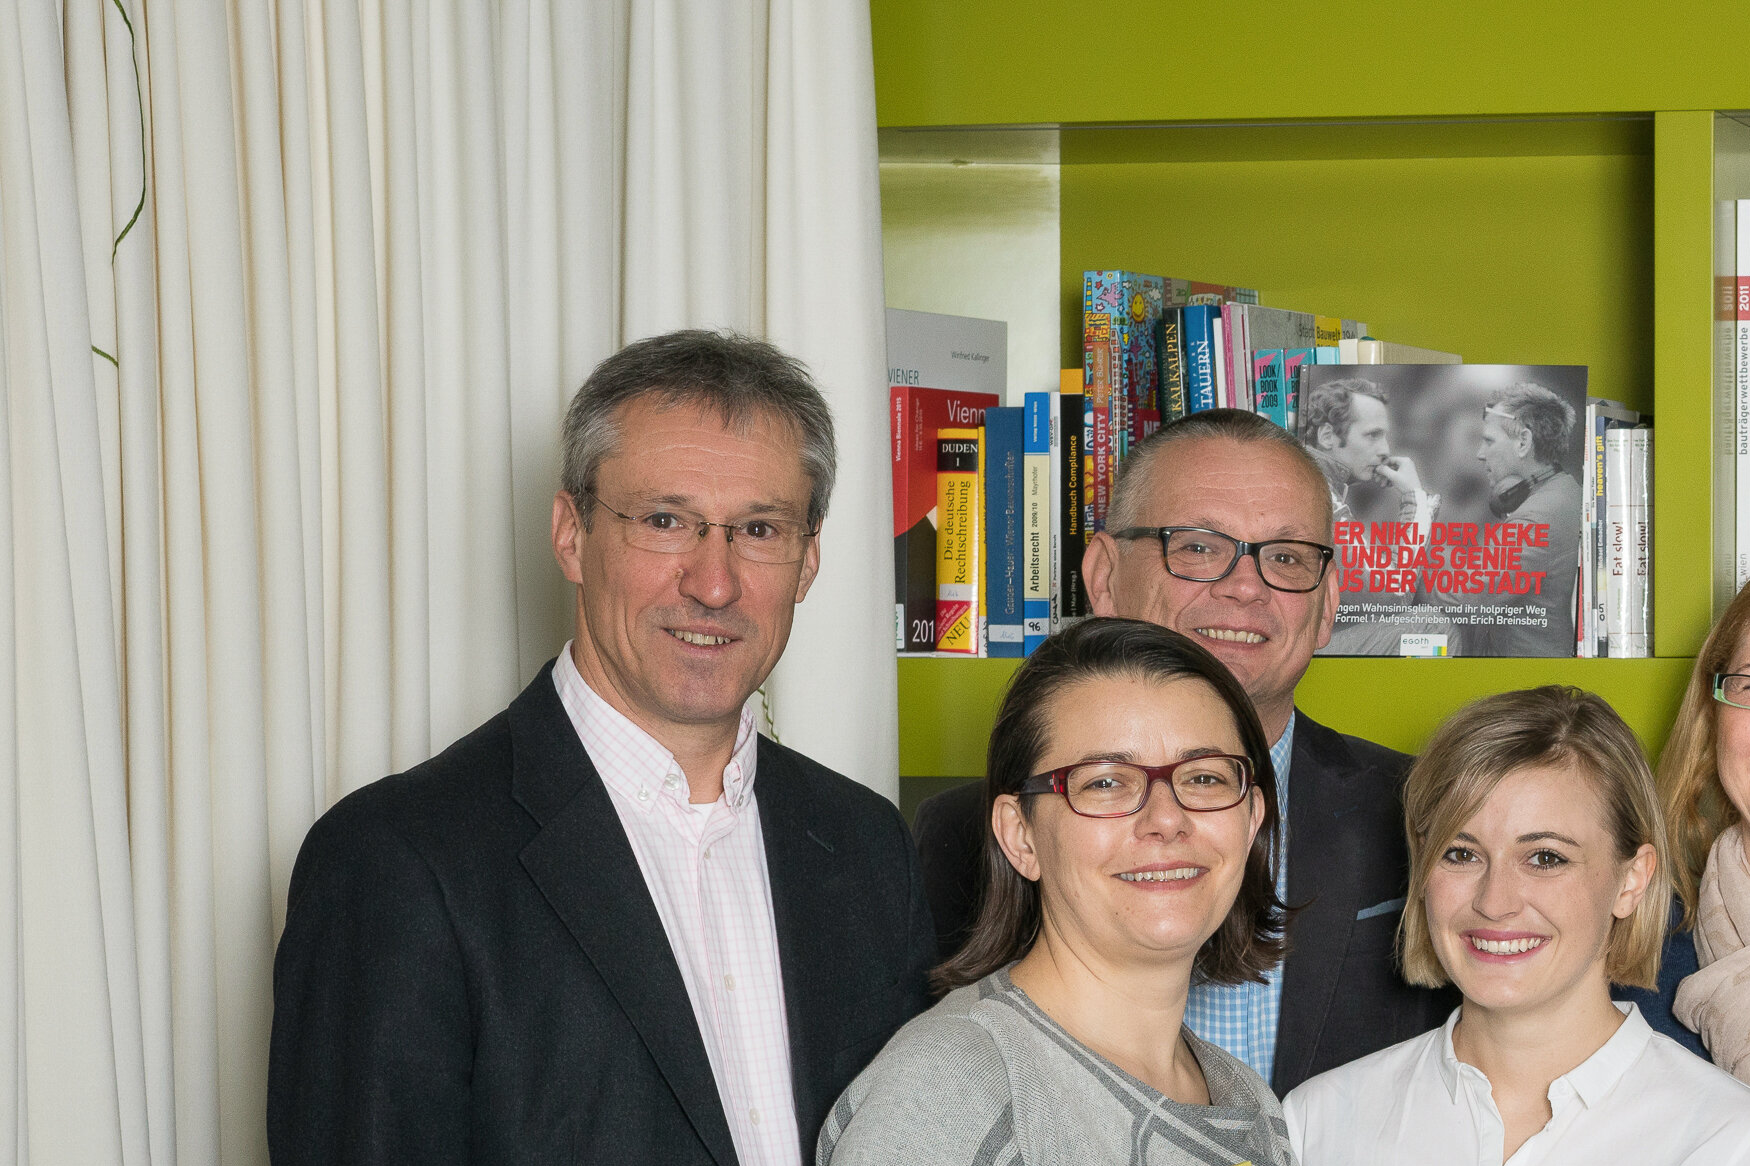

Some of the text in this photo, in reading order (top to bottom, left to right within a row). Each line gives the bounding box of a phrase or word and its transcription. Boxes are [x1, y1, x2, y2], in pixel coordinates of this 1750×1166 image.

[1740, 286, 1749, 311] 2011
[1166, 324, 1182, 412] KALKALPEN
[1197, 340, 1213, 408] TAUERN
[1260, 379, 1278, 393] BOOK
[1738, 327, 1749, 455] bauträgerwettbewerbe
[948, 400, 986, 424] Vienn
[1261, 395, 1279, 408] 2009
[942, 444, 978, 453] DUDEN
[1097, 413, 1106, 512] NEW YORK CITY
[1595, 435, 1605, 497] heaven's gift
[1069, 435, 1078, 535] Handbuch Compliance
[943, 480, 955, 561] Die deutsche
[954, 480, 971, 584] Rechtschreibung
[1334, 522, 1550, 548] ER NIKI, DER KEKE
[1612, 521, 1623, 552] slow!
[1029, 532, 1040, 592] Arbeitsrecht
[1341, 546, 1523, 571] UND DAS GENIE
[1613, 556, 1623, 576] Eat
[1337, 569, 1547, 595] US DER VORSTADT
[1335, 614, 1548, 628] Formel 1. Aufgeschrieben von Erich Breinsberg
[1337, 603, 1547, 617] ngen Wahnsinnsglüher und ihr holpriger Weg
[945, 615, 970, 645] NEU
[1028, 621, 1041, 632] 96
